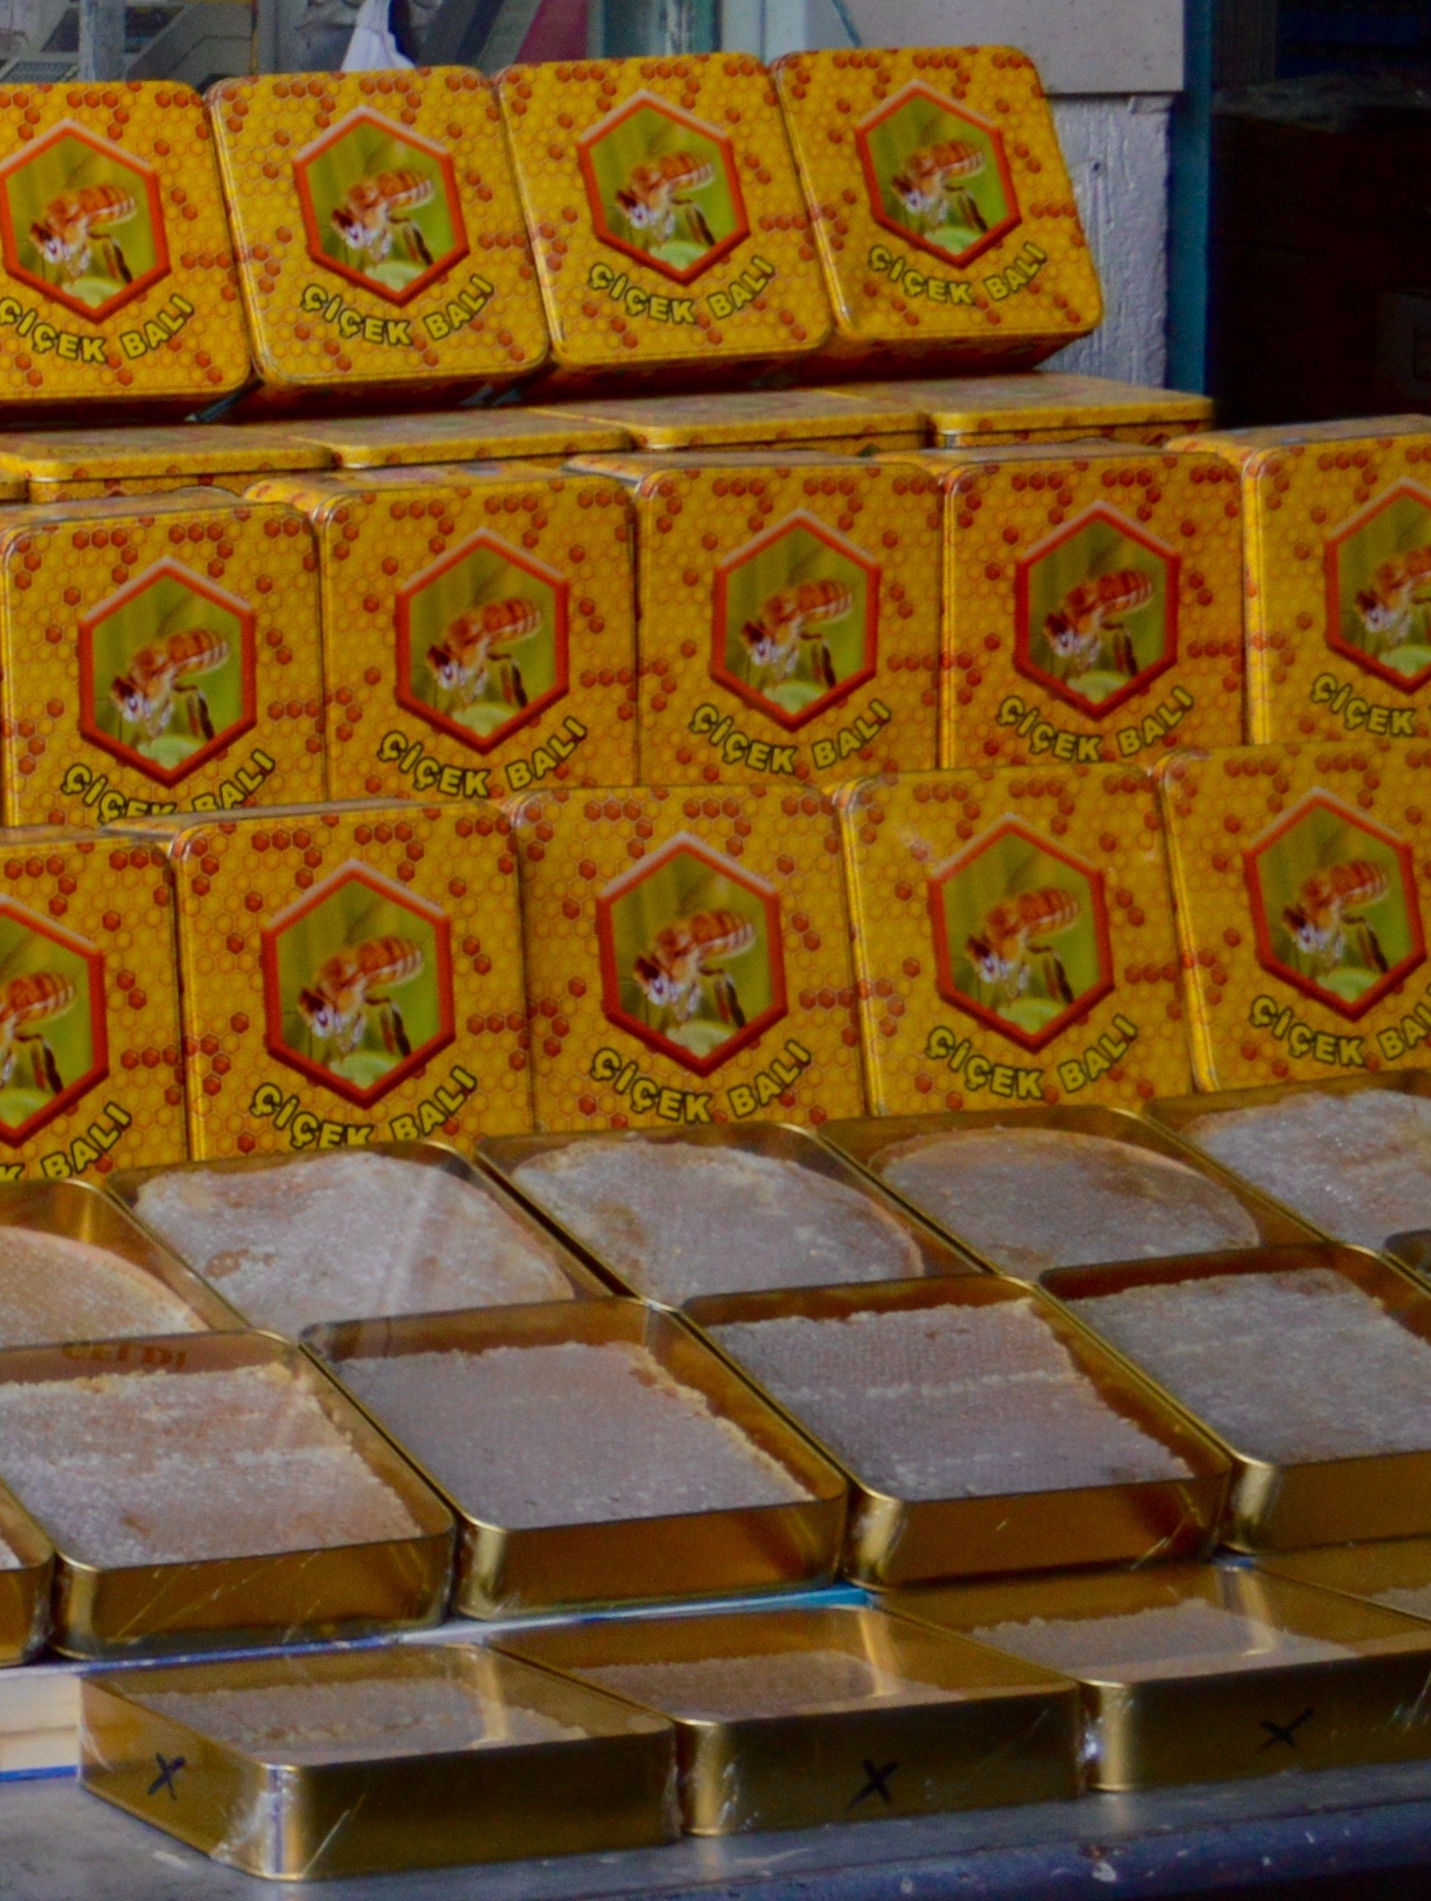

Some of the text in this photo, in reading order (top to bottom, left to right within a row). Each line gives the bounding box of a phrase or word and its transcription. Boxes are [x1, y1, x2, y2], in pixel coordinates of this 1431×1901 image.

[300, 273, 496, 347] ÇİÇEK BALI
[588, 255, 776, 326] ÇİÇEK BALI
[867, 241, 1048, 307] ÇİÇEK BALI
[121, 293, 194, 360] BALI
[688, 698, 892, 774] ÇİÇEK BALI
[997, 685, 1195, 761] ÇİÇEK BALI
[1311, 673, 1415, 736] ÇİÇEK
[190, 749, 276, 814] BALI
[378, 716, 588, 797] ÇİÇEK BALI
[924, 1014, 1139, 1101] ÇİÇEK BALI
[1249, 995, 1365, 1068] ÇİÇEK
[249, 1065, 479, 1148] ÇİÇEK BALI
[590, 1039, 813, 1124] ÇİÇEK BALI
[40, 1102, 135, 1181] BALI
